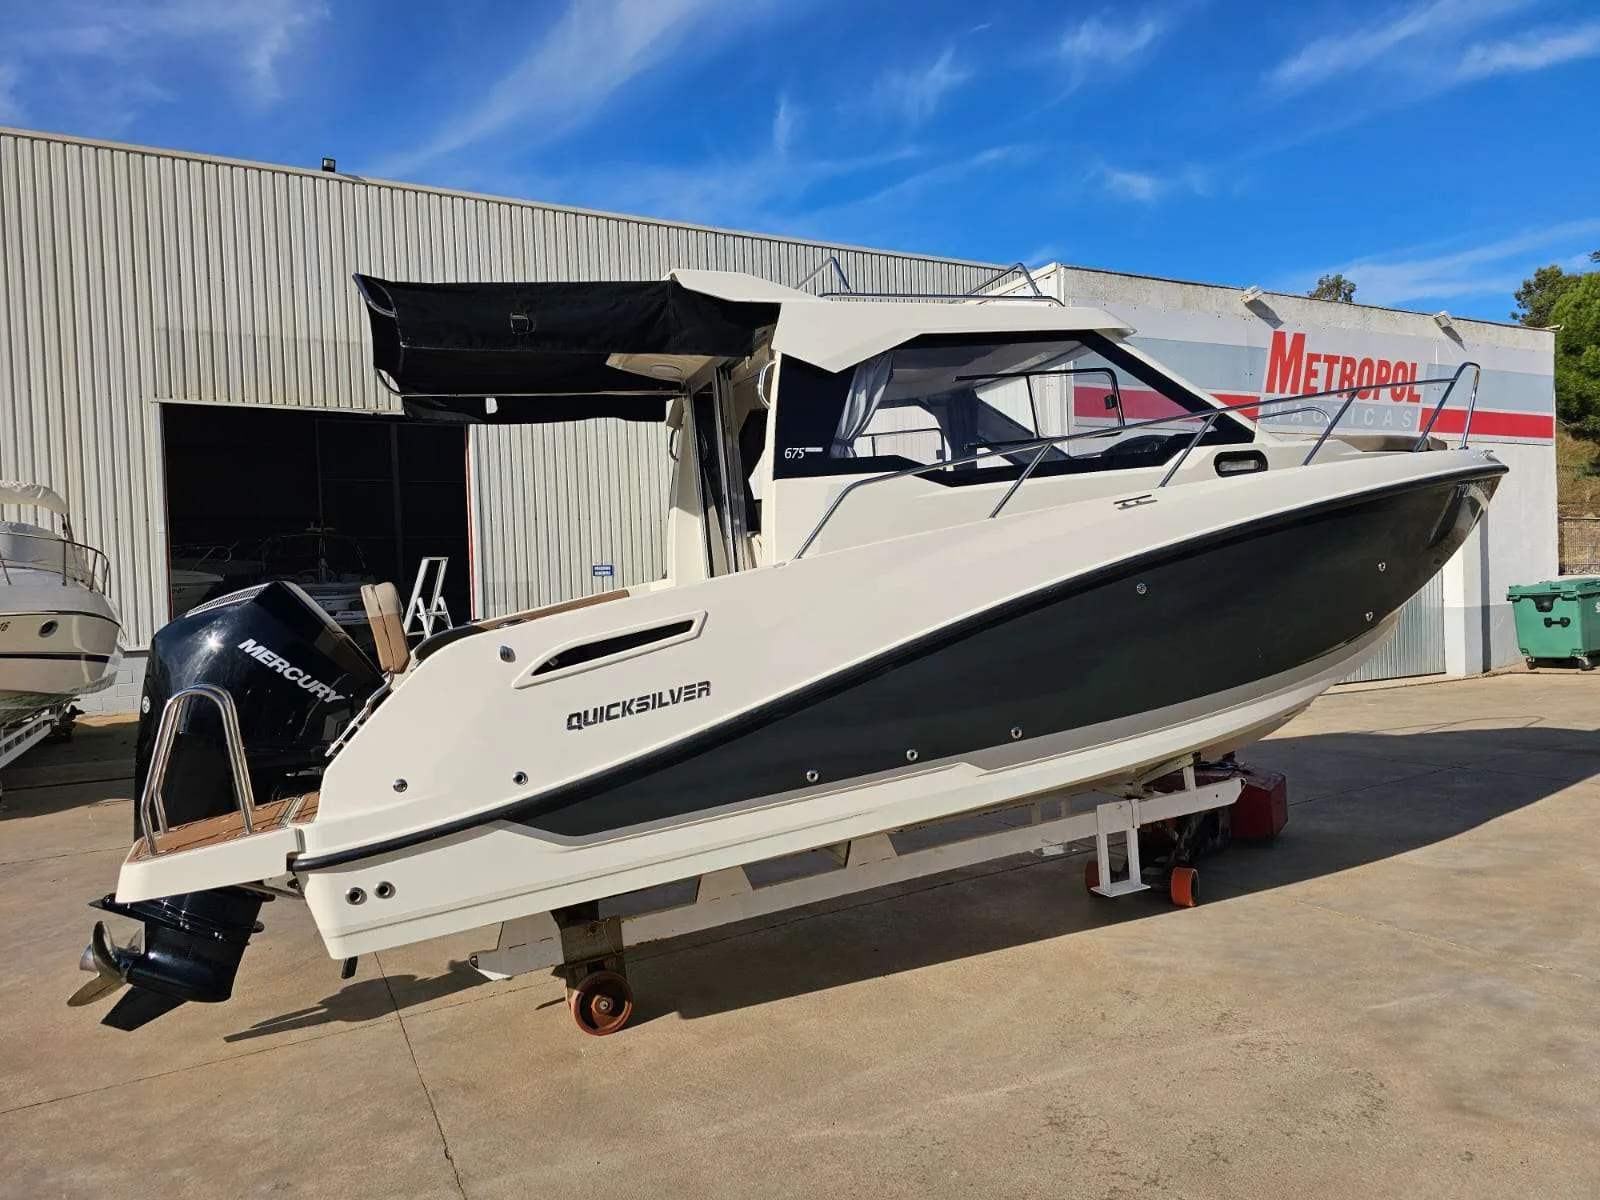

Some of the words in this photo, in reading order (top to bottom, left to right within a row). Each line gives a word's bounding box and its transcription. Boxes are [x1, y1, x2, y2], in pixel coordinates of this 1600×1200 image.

[1266, 331, 1421, 403] METROPOL
[784, 447, 805, 459] 675
[238, 638, 345, 702] MERCURY
[566, 680, 711, 731] QUICKSILVER
